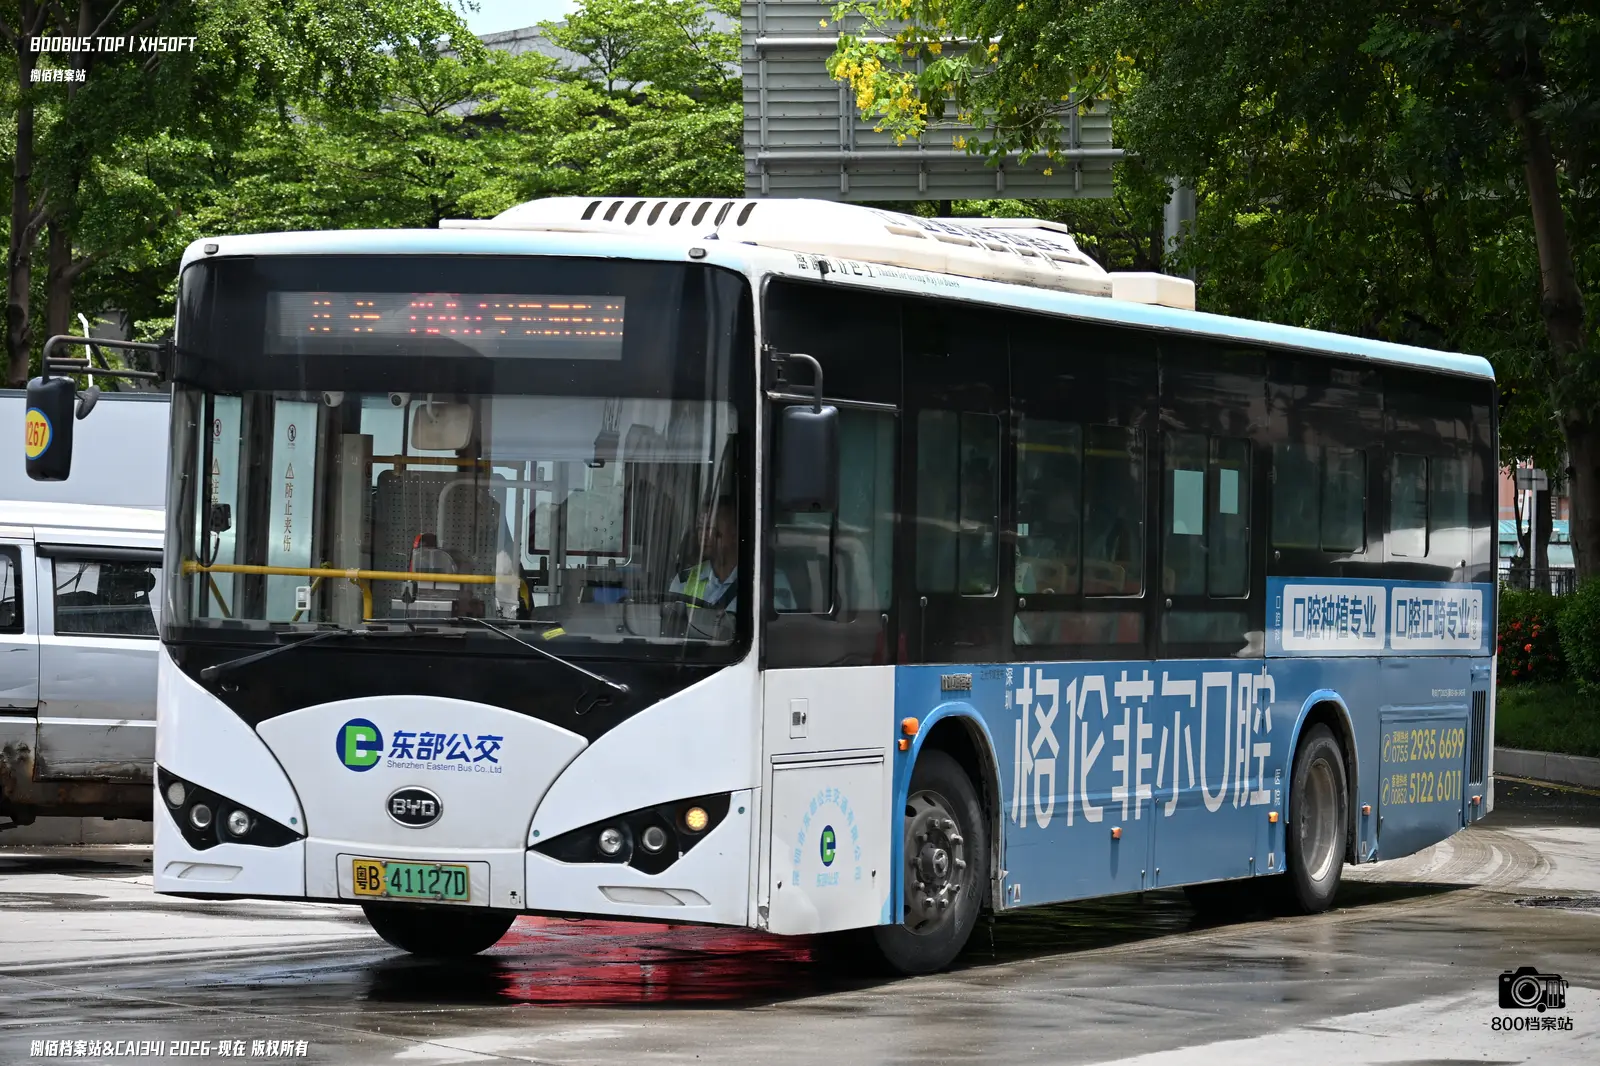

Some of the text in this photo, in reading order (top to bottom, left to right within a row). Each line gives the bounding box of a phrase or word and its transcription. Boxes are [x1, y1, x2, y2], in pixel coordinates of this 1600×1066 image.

[283, 482, 294, 552] 防止夹伤
[1293, 594, 1377, 640] 口腔种植专业
[1396, 596, 1471, 640] 口腔正畸专业
[388, 730, 504, 764] 东部公交
[1011, 667, 1276, 829] 格伦菲尔口腔
[1391, 727, 1465, 762] 0755 2935 6699
[387, 760, 425, 770] Shenzhen
[426, 762, 456, 772] Eastern
[458, 763, 473, 773] Bus
[1409, 771, 1433, 803] 5122
[1436, 770, 1461, 802] 6011
[392, 798, 435, 817] BYD
[356, 865, 466, 897] 粤B 41127D
